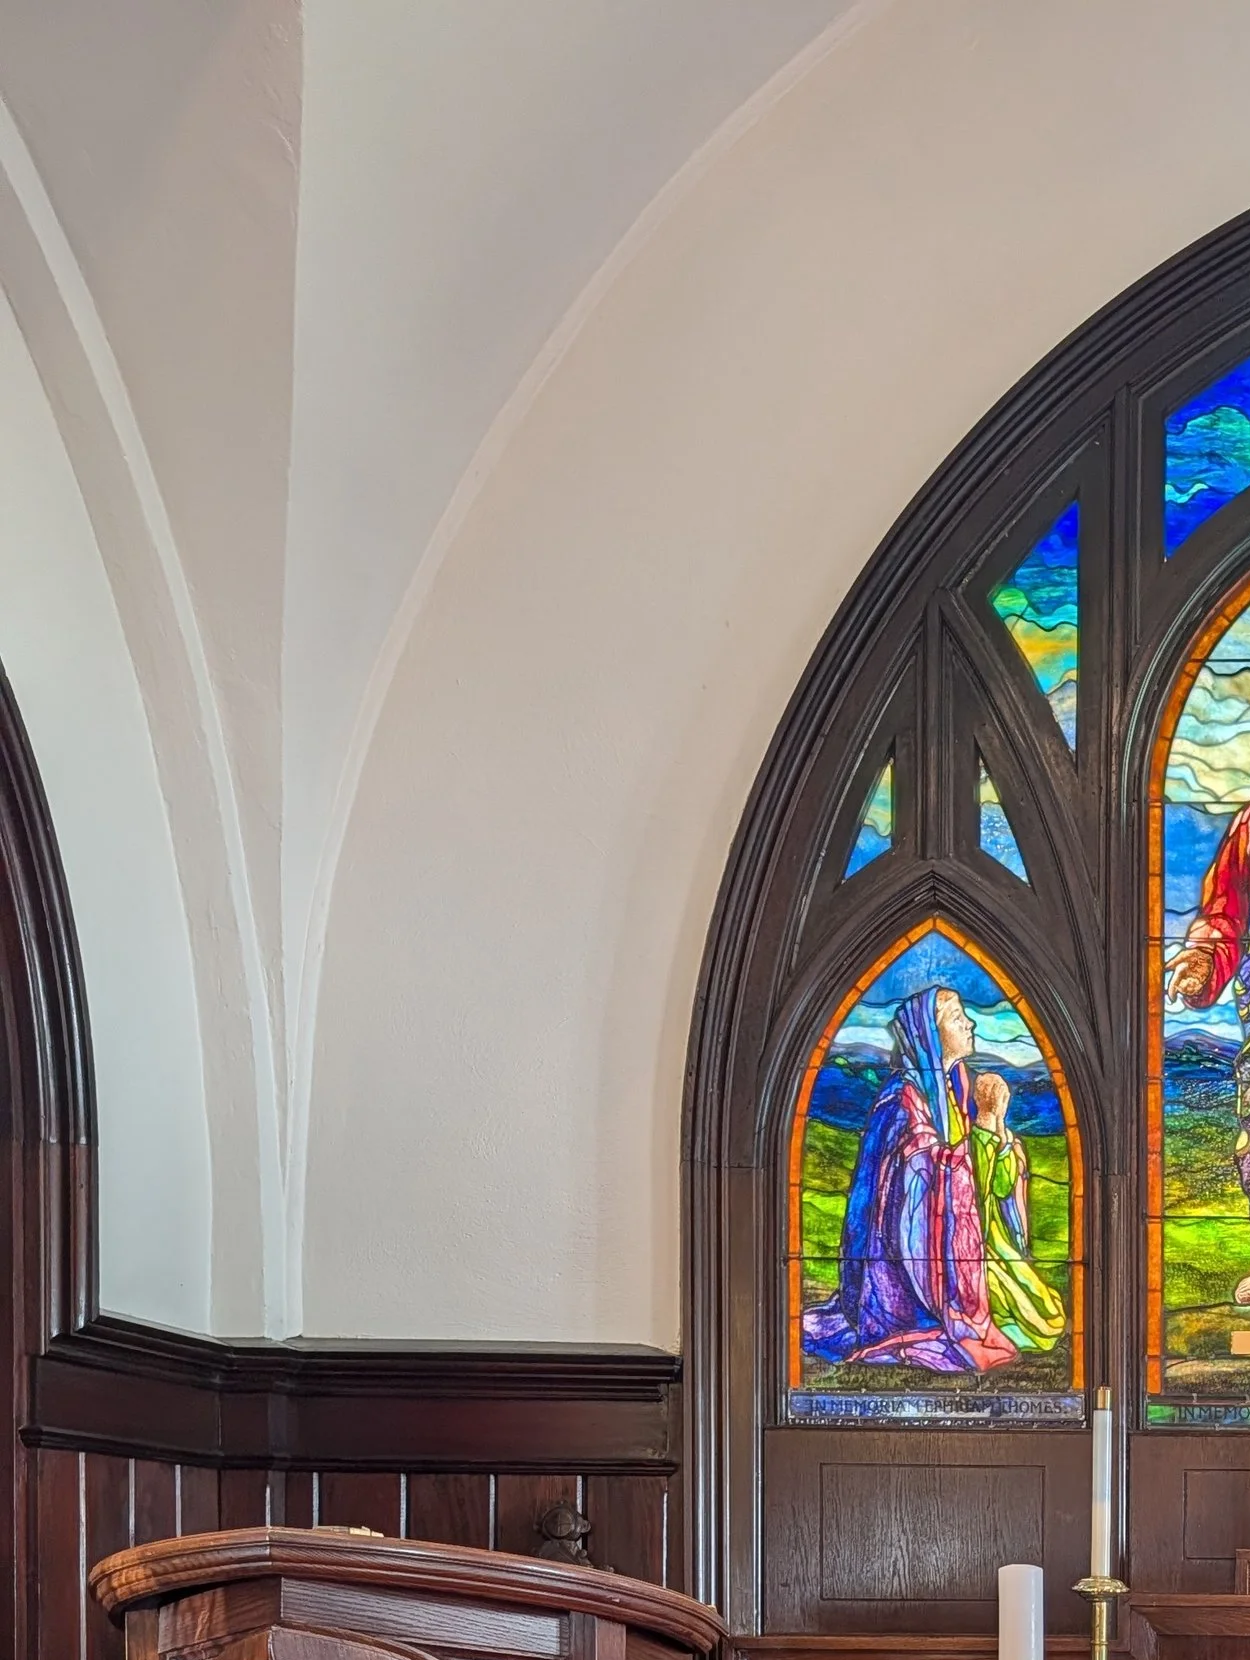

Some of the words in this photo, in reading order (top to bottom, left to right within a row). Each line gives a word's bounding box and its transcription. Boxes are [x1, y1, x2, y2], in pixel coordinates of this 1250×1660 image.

[811, 1399, 826, 1413] IN
[832, 1399, 922, 1414] MEMORIAM
[1178, 1406, 1195, 1420] IN
